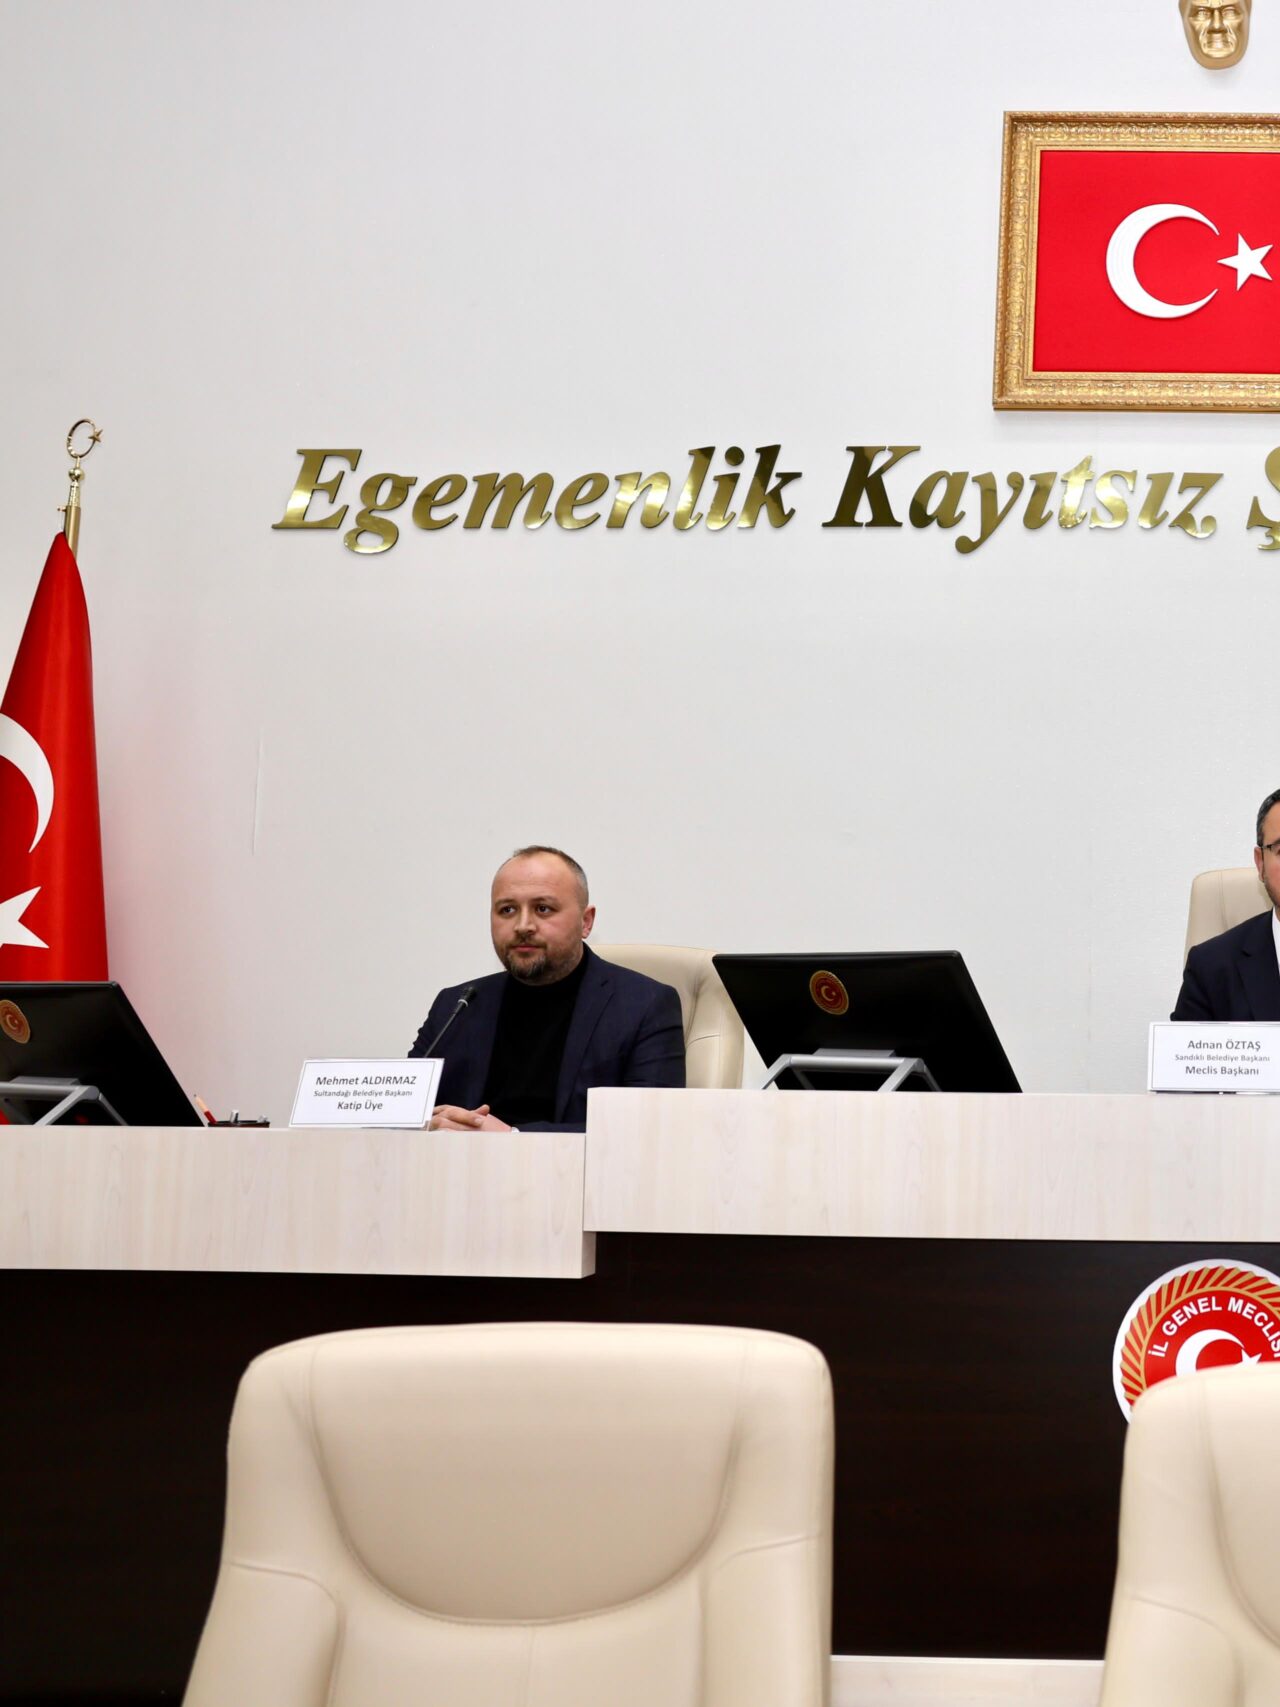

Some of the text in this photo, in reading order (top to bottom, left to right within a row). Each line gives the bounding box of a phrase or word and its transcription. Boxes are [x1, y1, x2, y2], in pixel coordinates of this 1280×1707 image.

[271, 444, 802, 555] Egemenlik
[822, 445, 1224, 555] Kayıtsız
[1187, 1039, 1261, 1051] Adnan ÖZTAŞ
[1206, 1054, 1239, 1062] Belediye
[1240, 1055, 1270, 1063] Başkanı
[1185, 1066, 1260, 1076] Meclis Başkanı
[315, 1075, 417, 1086] Mehmet ALDIRMAZ
[313, 1090, 413, 1098] Sultandağı Belediye Başkanı
[337, 1100, 383, 1111] Katip Üye
[1148, 1341, 1170, 1358] İL
[1161, 1296, 1223, 1337] GENEL
